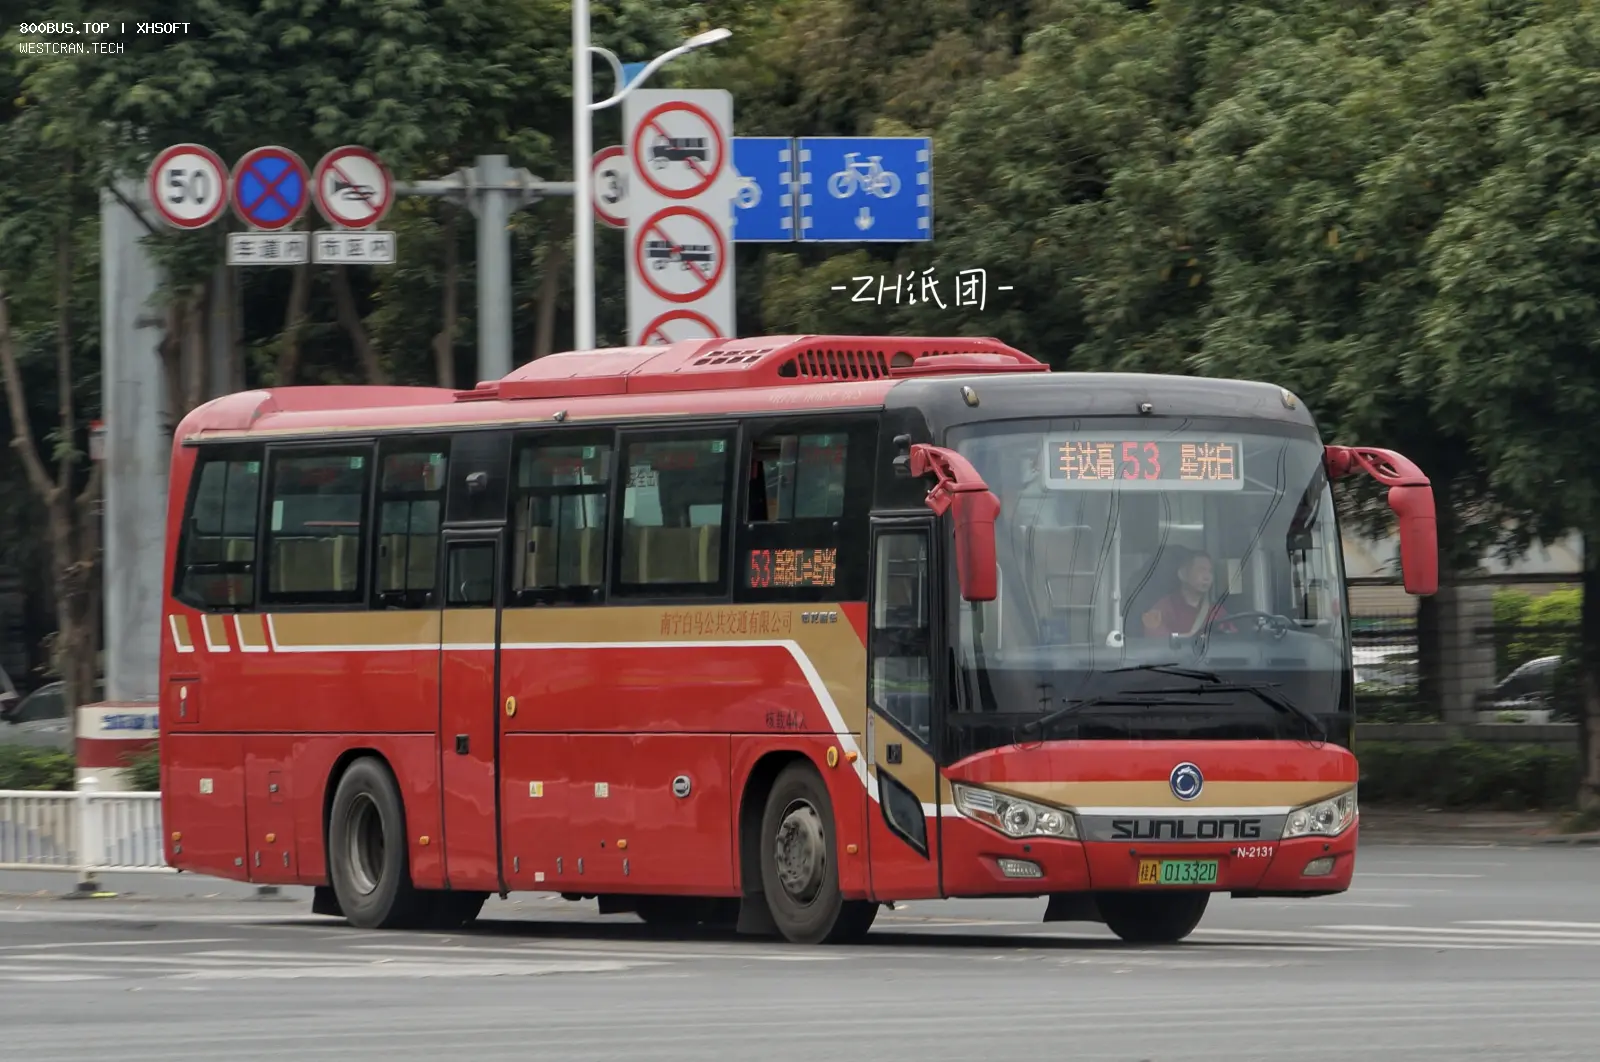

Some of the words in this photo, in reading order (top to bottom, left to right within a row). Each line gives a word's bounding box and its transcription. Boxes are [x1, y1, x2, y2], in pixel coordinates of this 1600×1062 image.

[165, 168, 209, 205] 50
[601, 169, 629, 204] 3
[1059, 441, 1115, 480] 丰达高
[1121, 441, 1161, 480] 53
[1180, 442, 1234, 480] 星光白
[750, 549, 772, 588] 53
[660, 610, 792, 636] 南宁白马公共交通有限公司
[1111, 819, 1261, 839] SUNLONG
[1237, 845, 1273, 858] N-2131
[1163, 863, 1217, 881] 01332D
